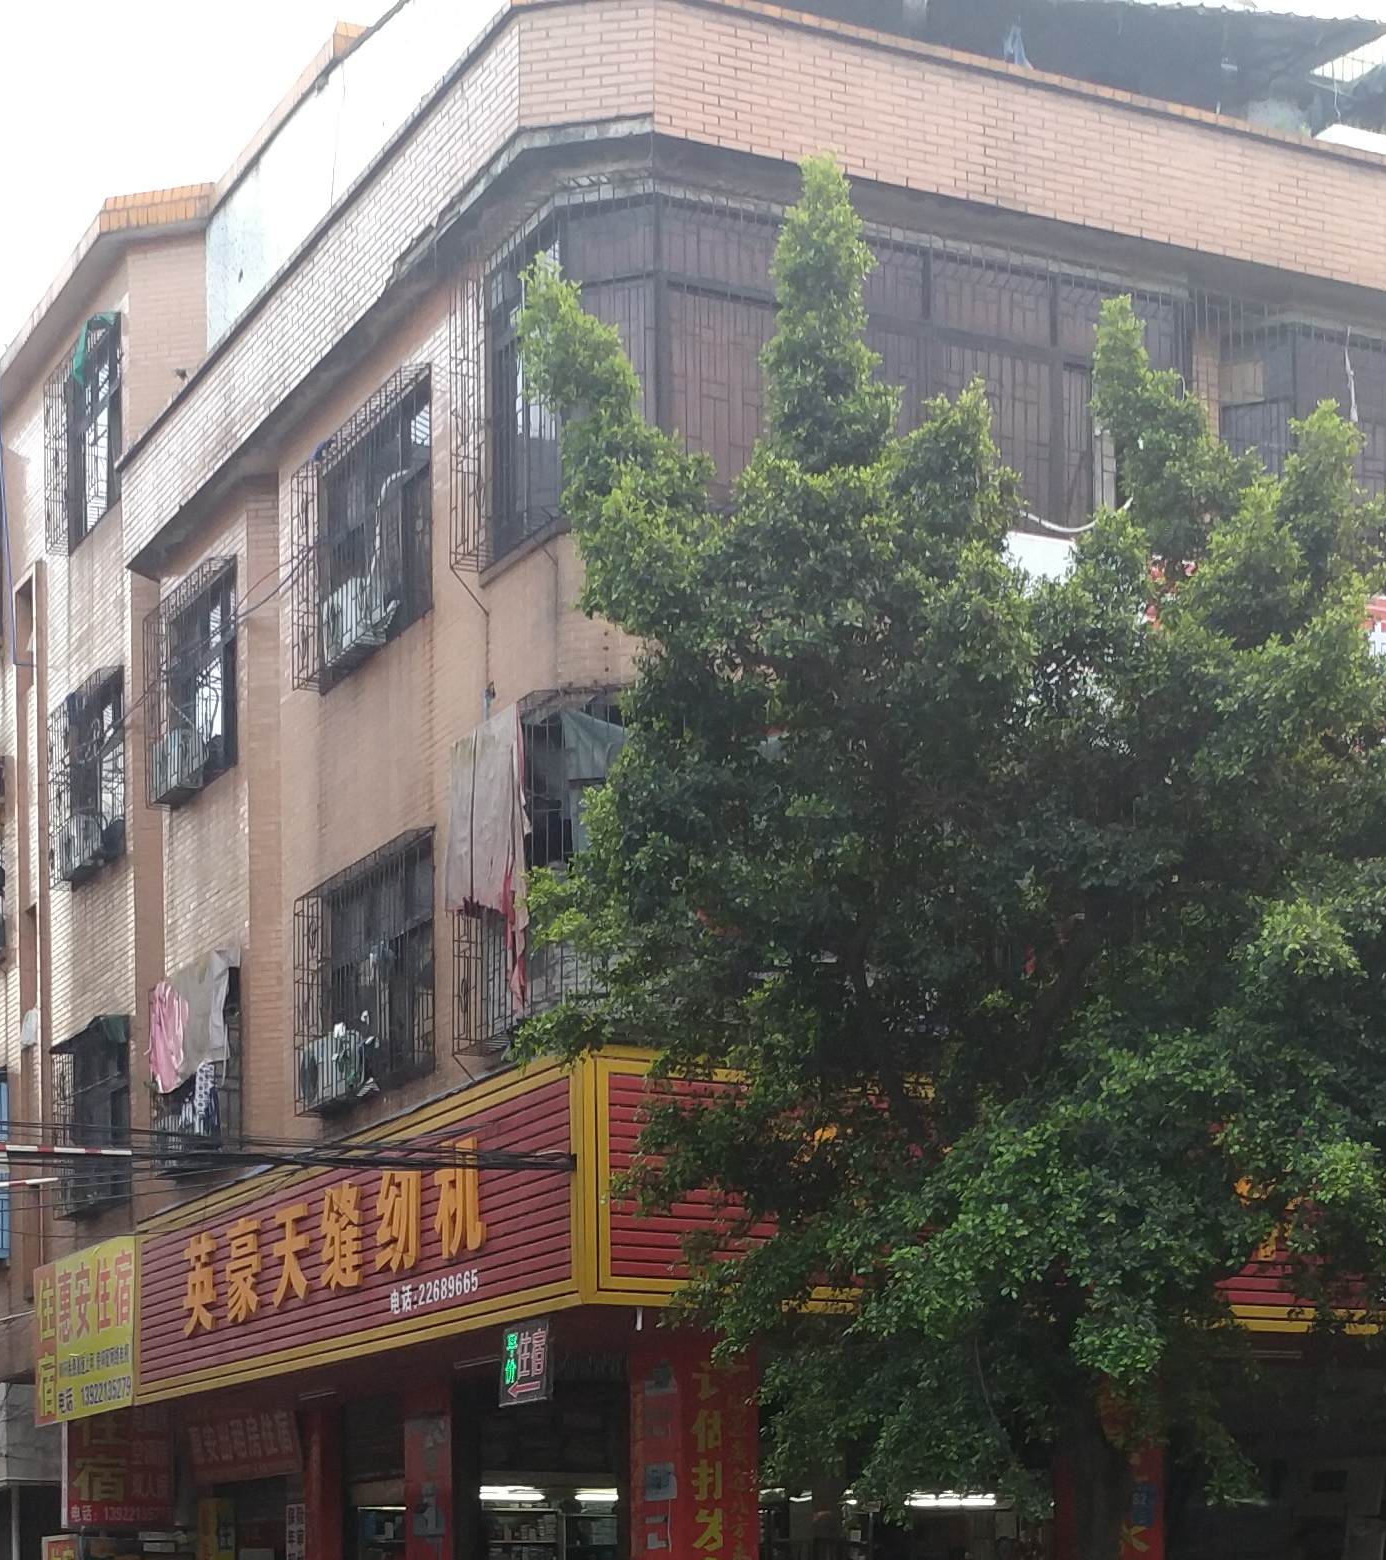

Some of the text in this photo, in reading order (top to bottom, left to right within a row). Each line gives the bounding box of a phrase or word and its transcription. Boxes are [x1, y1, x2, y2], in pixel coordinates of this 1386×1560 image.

[181, 1137, 486, 1338] 英豪天缝纫机
[58, 1250, 133, 1343] 惠安住宿
[37, 1278, 56, 1418] 住宿
[518, 1328, 547, 1381] 住宿
[71, 1408, 128, 1501] 住宿
